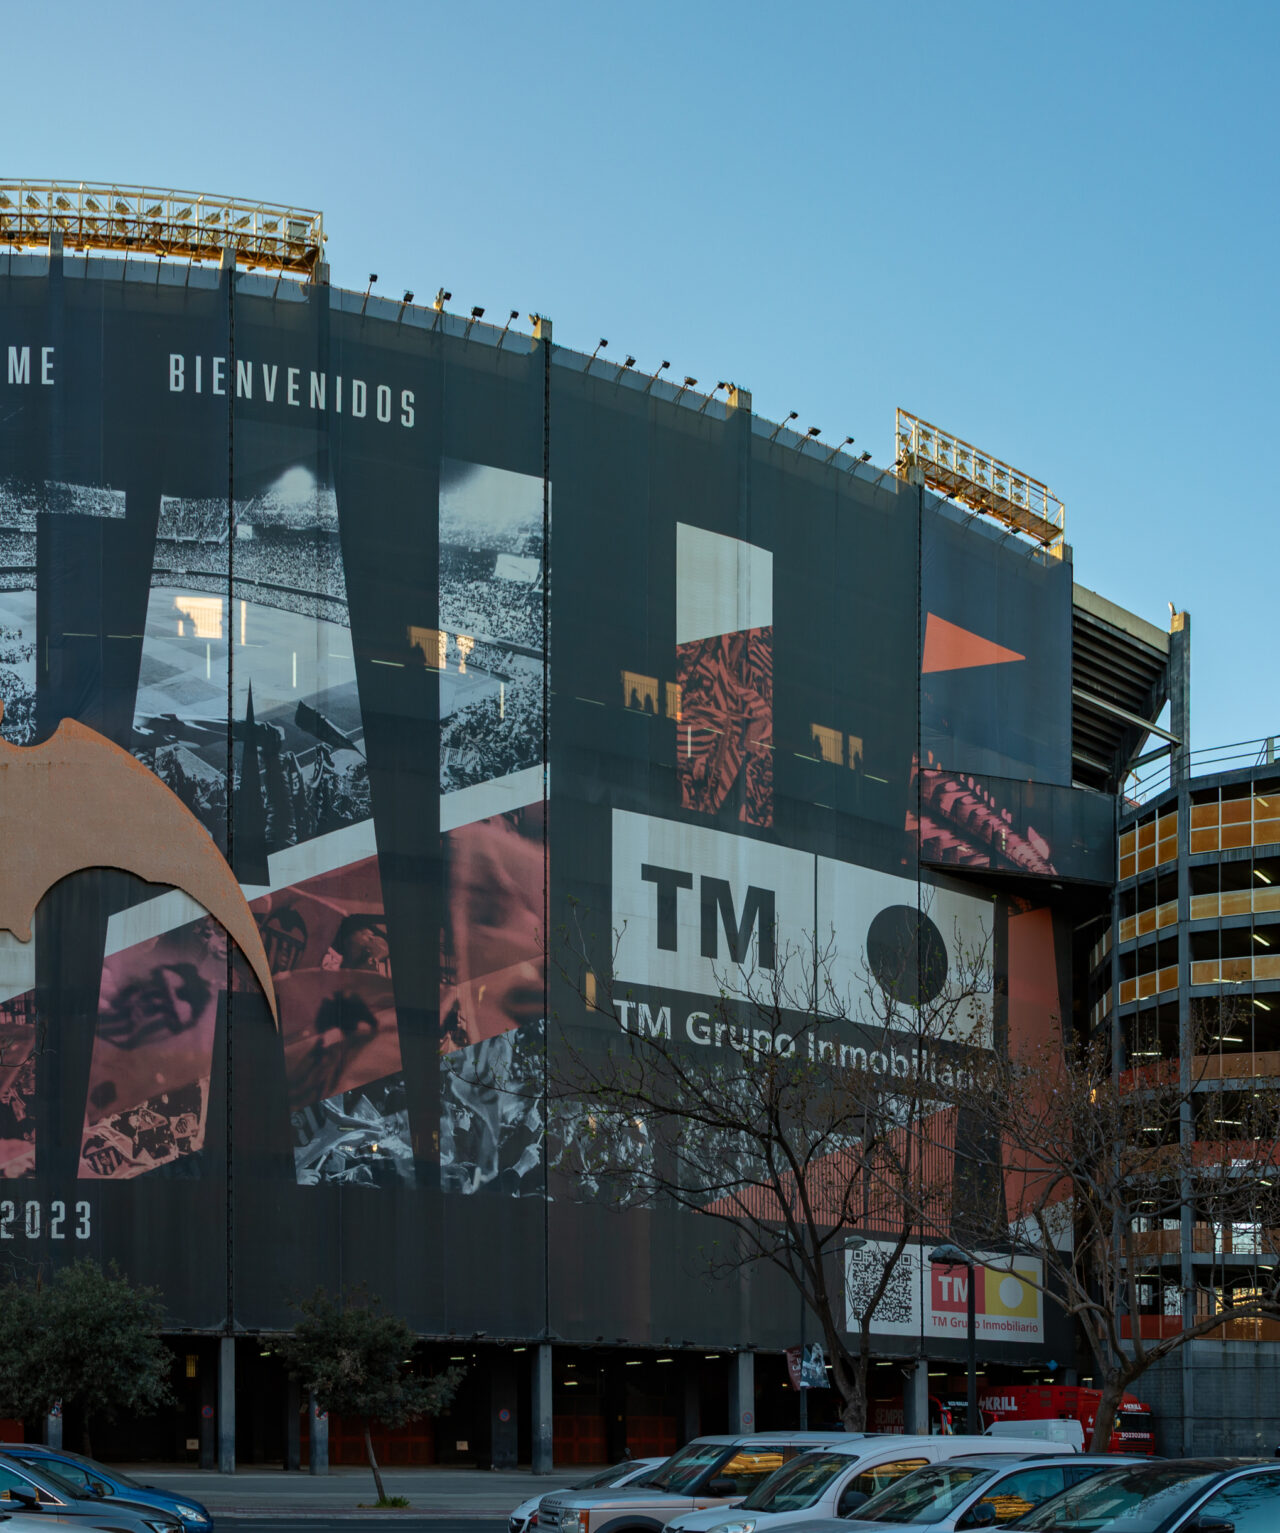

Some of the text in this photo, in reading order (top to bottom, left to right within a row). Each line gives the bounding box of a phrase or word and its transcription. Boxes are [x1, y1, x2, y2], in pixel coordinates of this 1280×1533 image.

[169, 353, 415, 427] BIENVENIDOS
[641, 863, 775, 969] TM
[613, 999, 671, 1040] TM
[686, 1011, 795, 1062] Grupo
[0, 1200, 91, 1239] 2023
[938, 1275, 969, 1303] TM
[932, 1316, 1038, 1333] TM Gruo Inmobiliario
[985, 1396, 1018, 1411] KRILL
